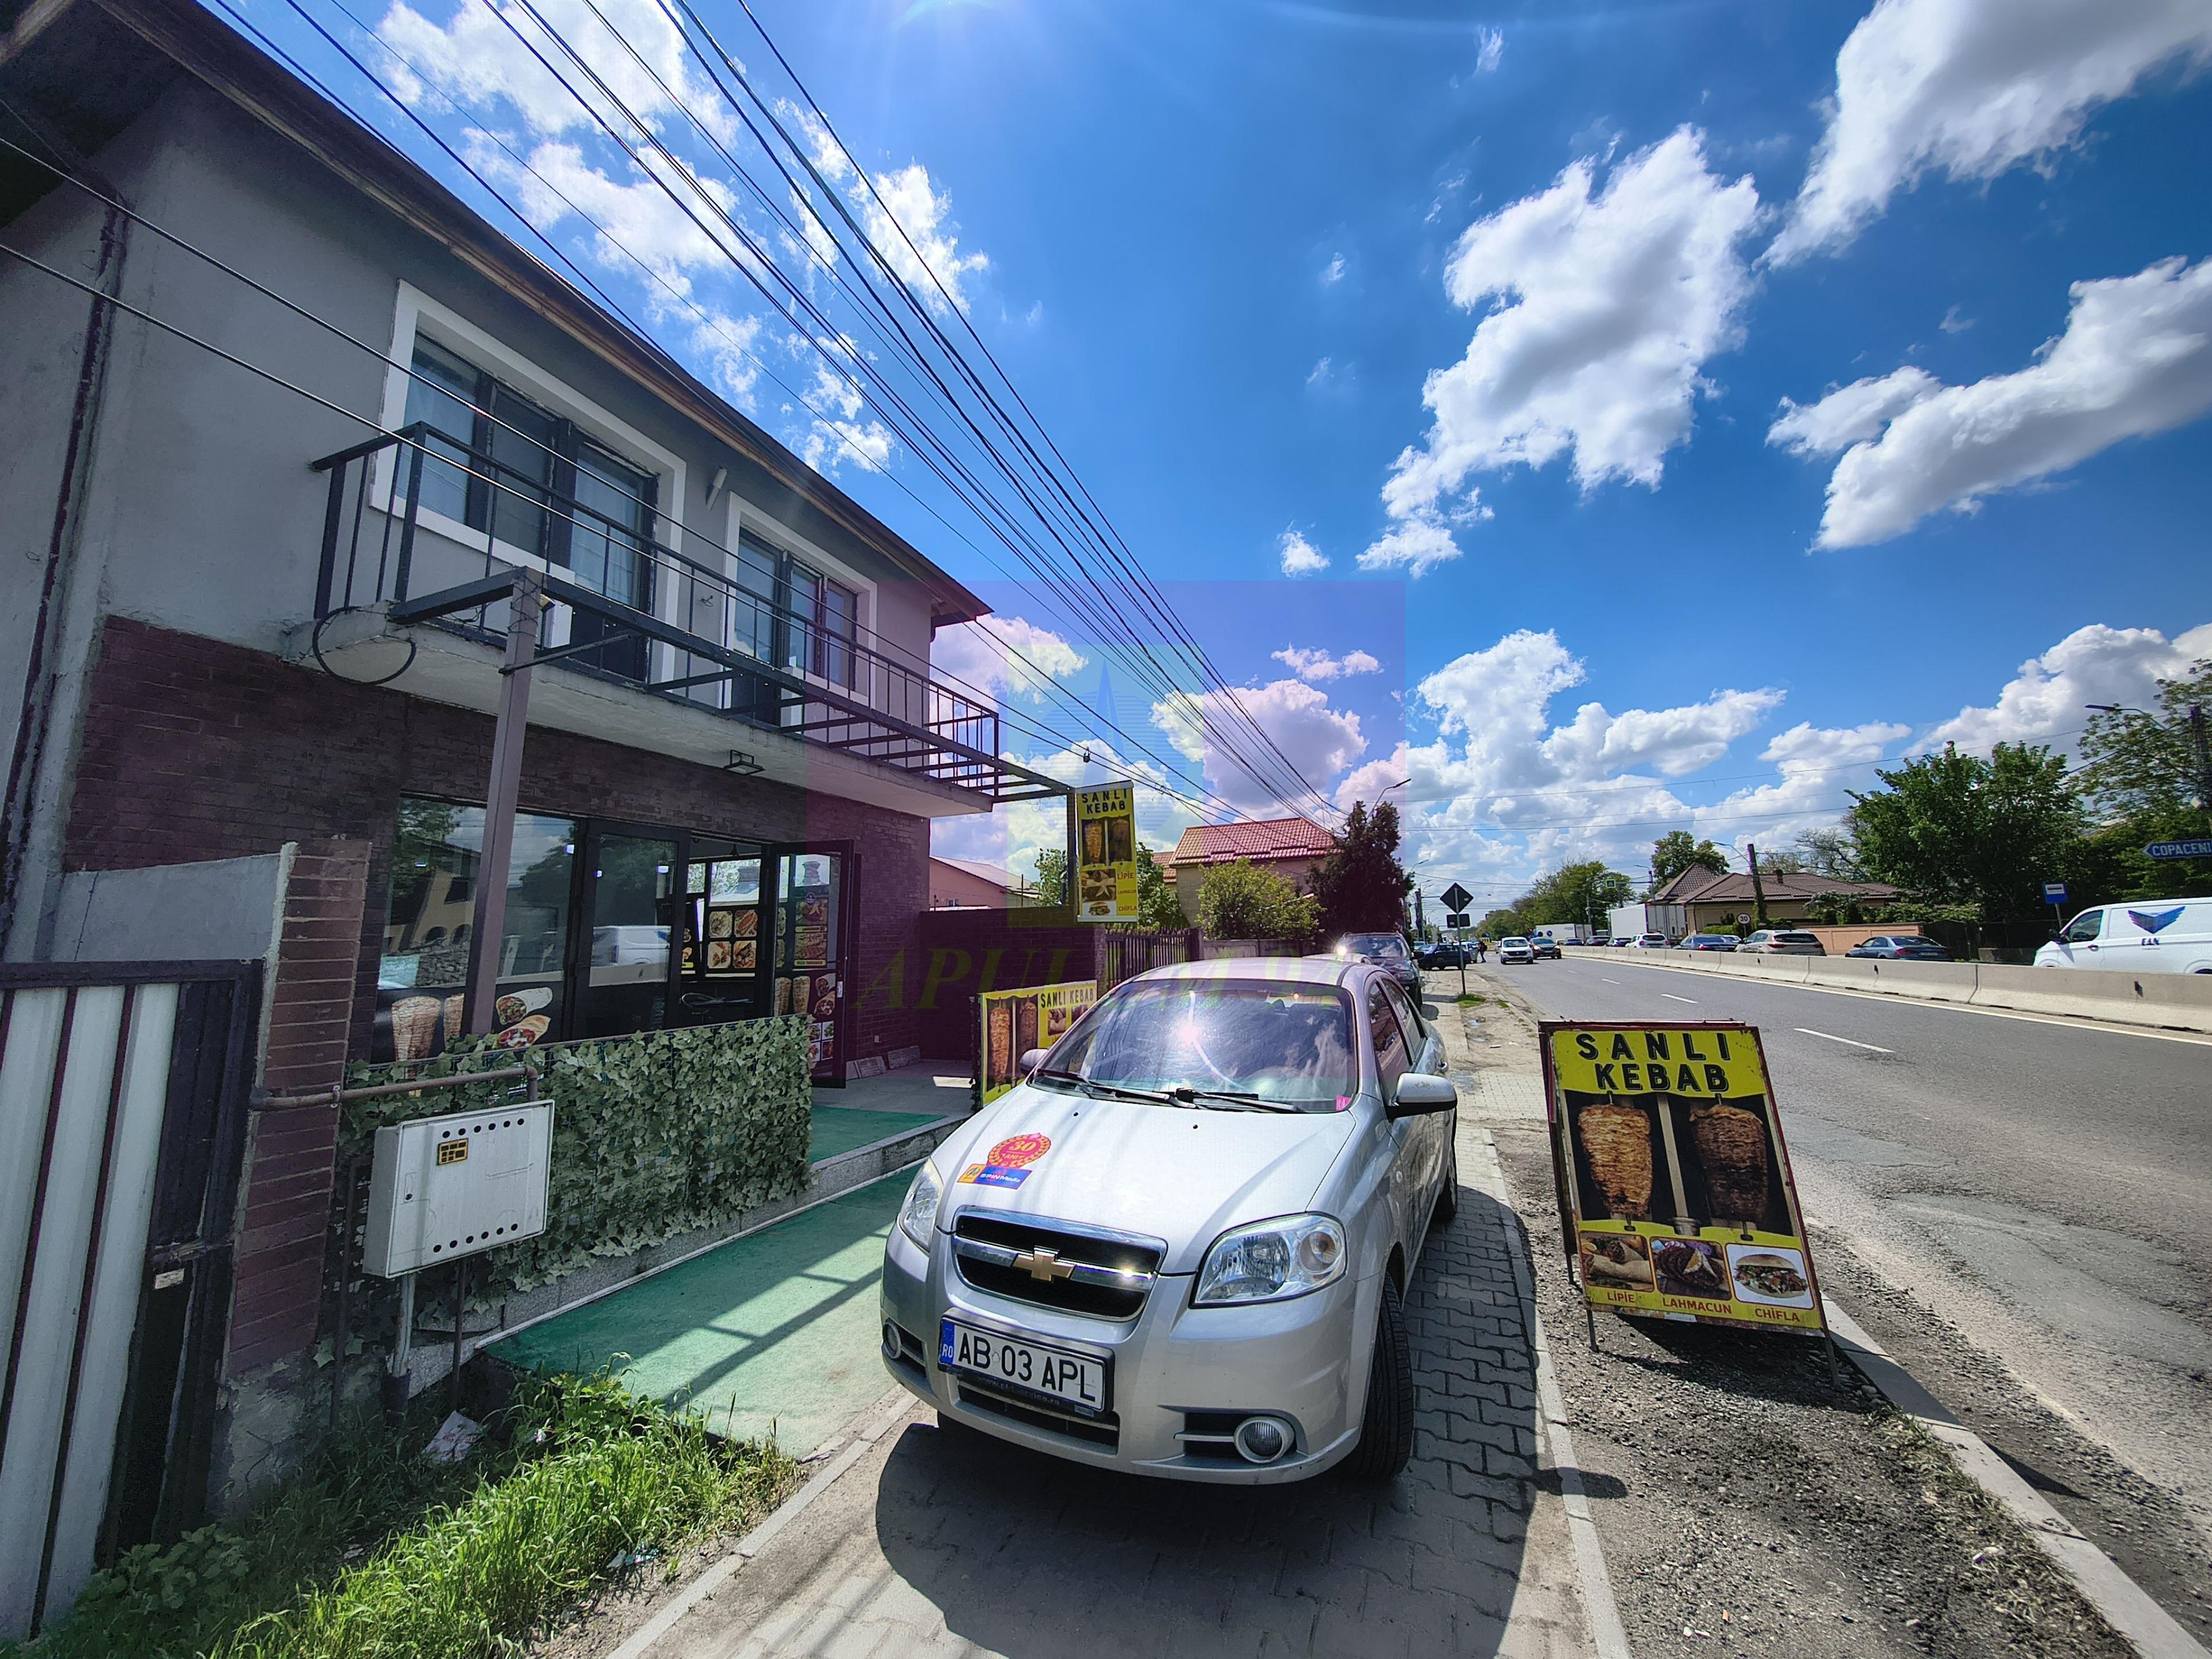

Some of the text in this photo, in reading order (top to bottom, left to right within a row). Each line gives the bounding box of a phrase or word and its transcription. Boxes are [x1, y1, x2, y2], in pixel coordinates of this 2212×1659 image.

[1081, 789, 1127, 804] SANLI
[1086, 800, 1126, 815] KEBAB
[2152, 842, 2211, 856] COPACENI
[1040, 987, 1094, 1008] SANLI KEBAB
[1574, 1032, 1731, 1062] SANLI
[1594, 1062, 1729, 1093] KEBAB
[1009, 1140, 1037, 1152] 30
[1662, 1297, 1732, 1315] LAHMACUN
[941, 1332, 1096, 1402] RO AB 03 APL
